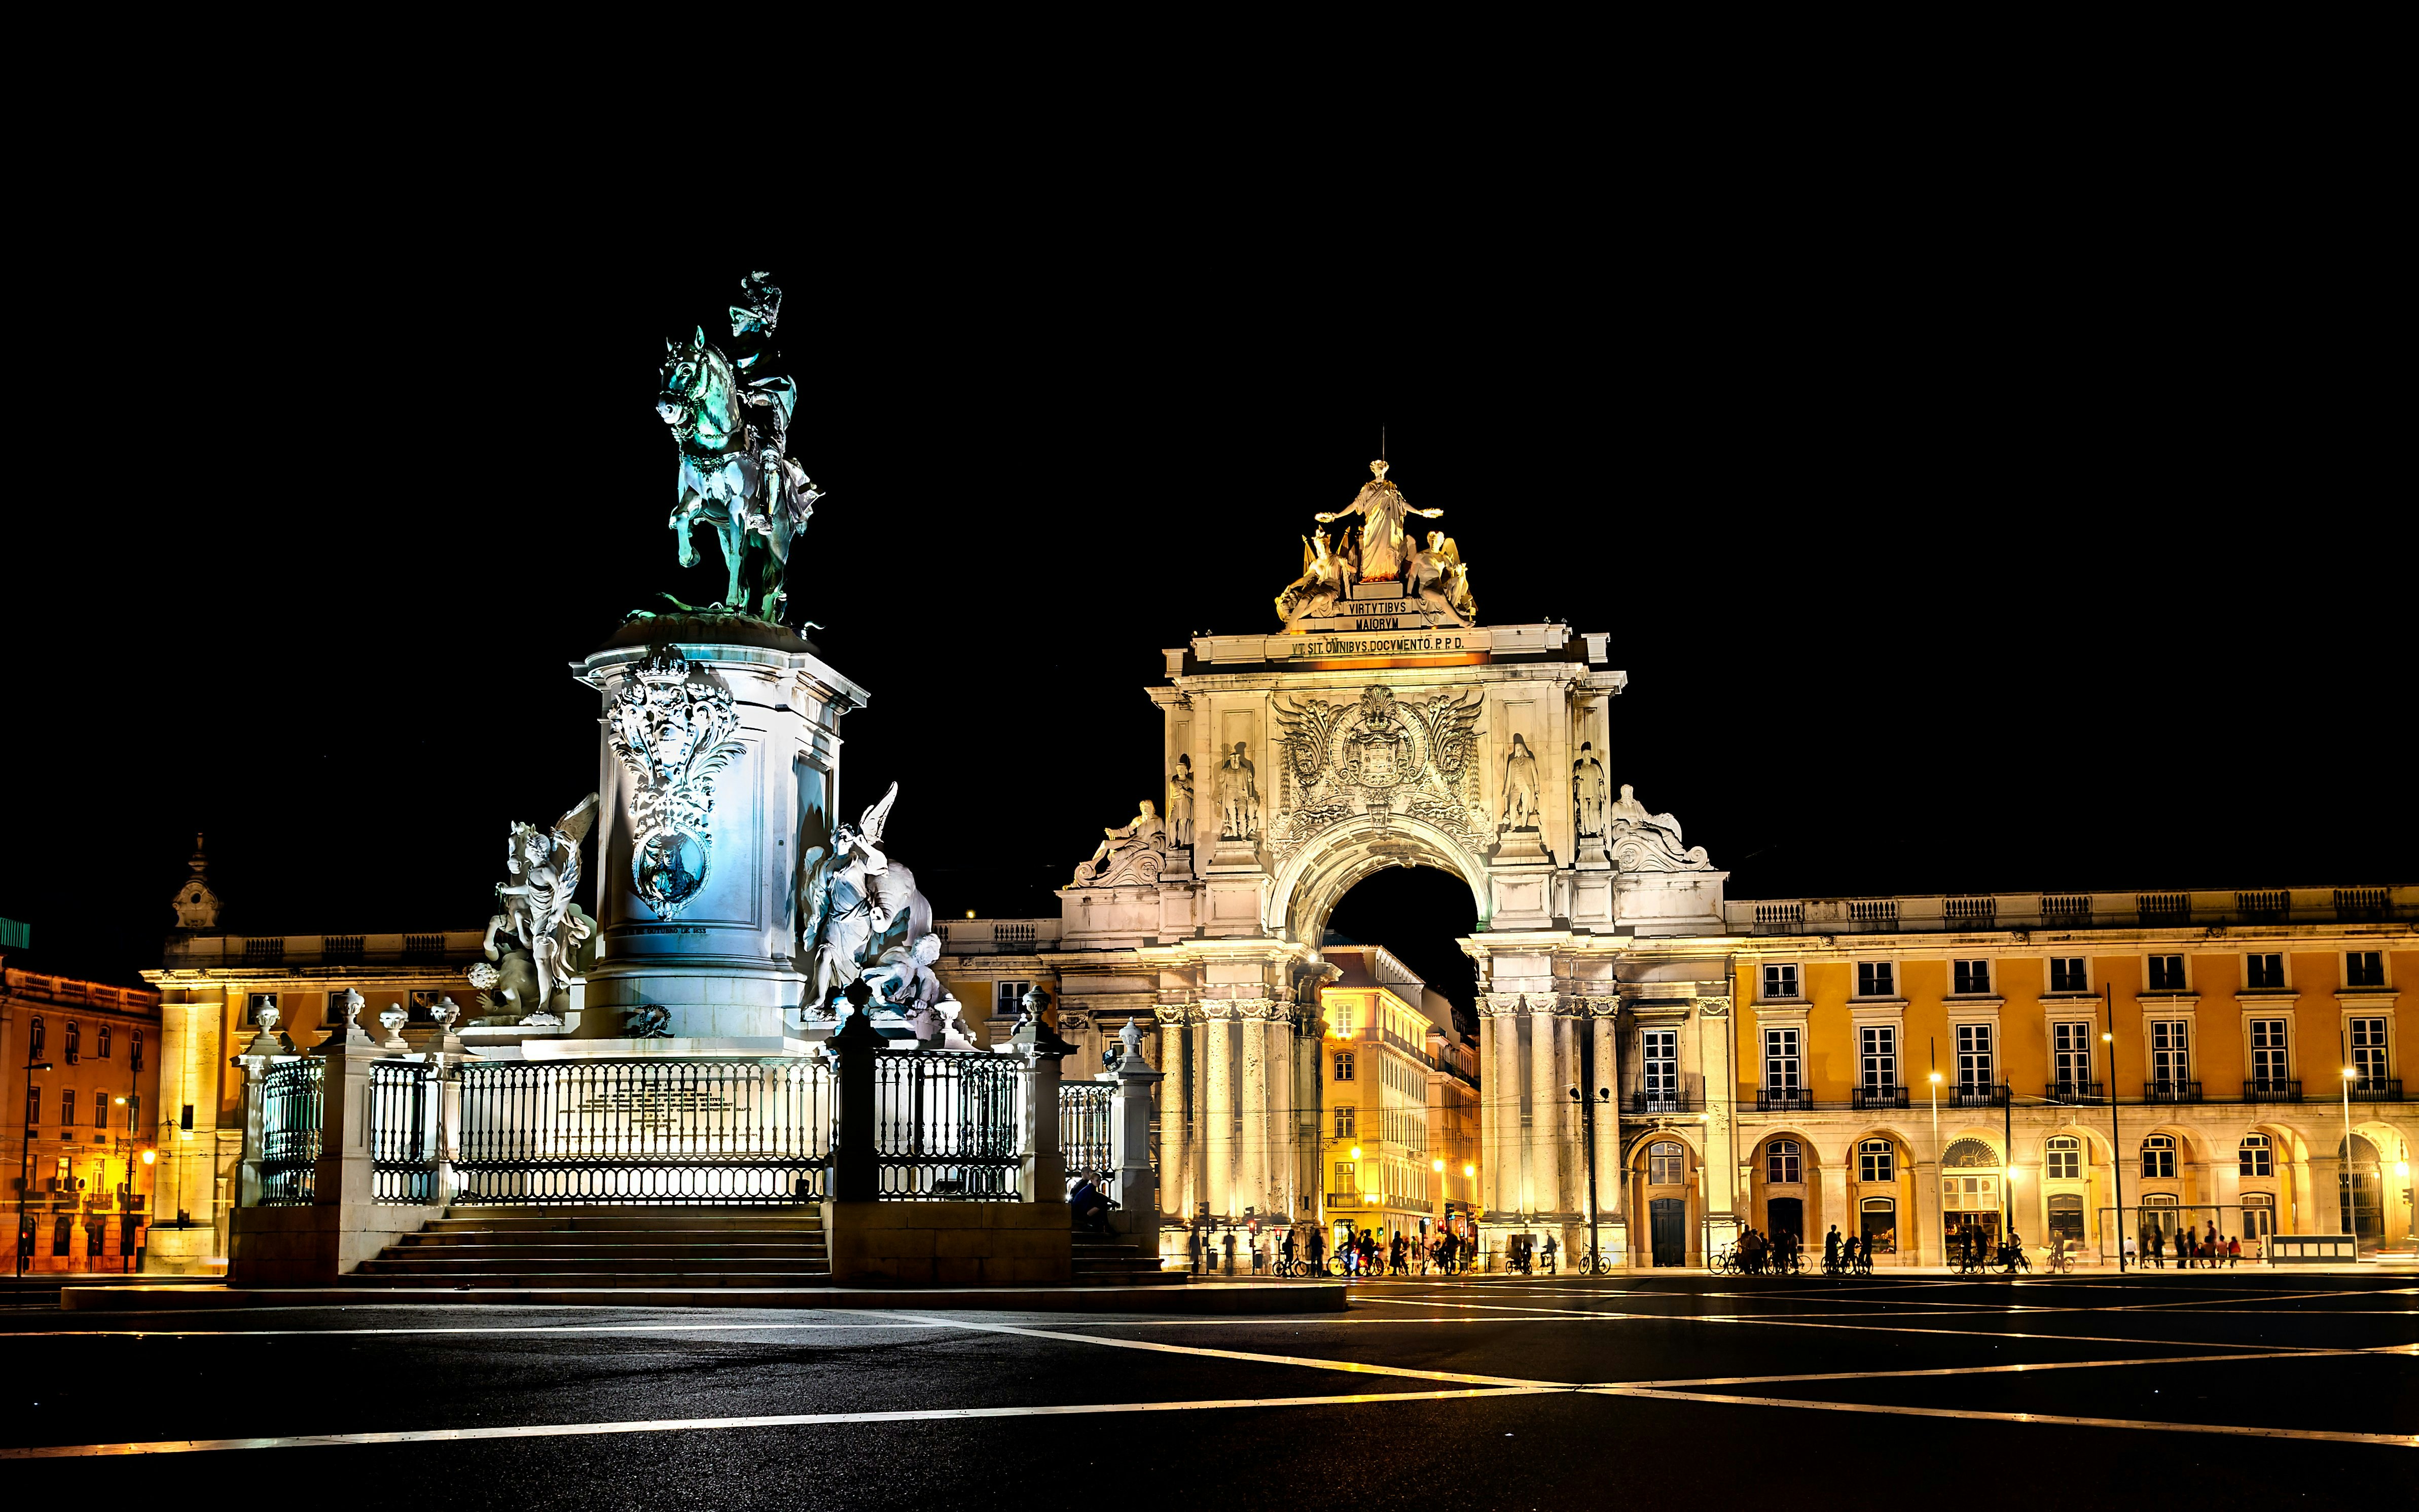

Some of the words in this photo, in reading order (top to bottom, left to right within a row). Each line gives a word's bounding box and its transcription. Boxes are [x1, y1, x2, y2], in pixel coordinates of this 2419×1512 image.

[1349, 602, 1406, 614] VIRTVTIBVS
[1356, 618, 1398, 630] MAIORVM
[1308, 642, 1323, 654] SIT.
